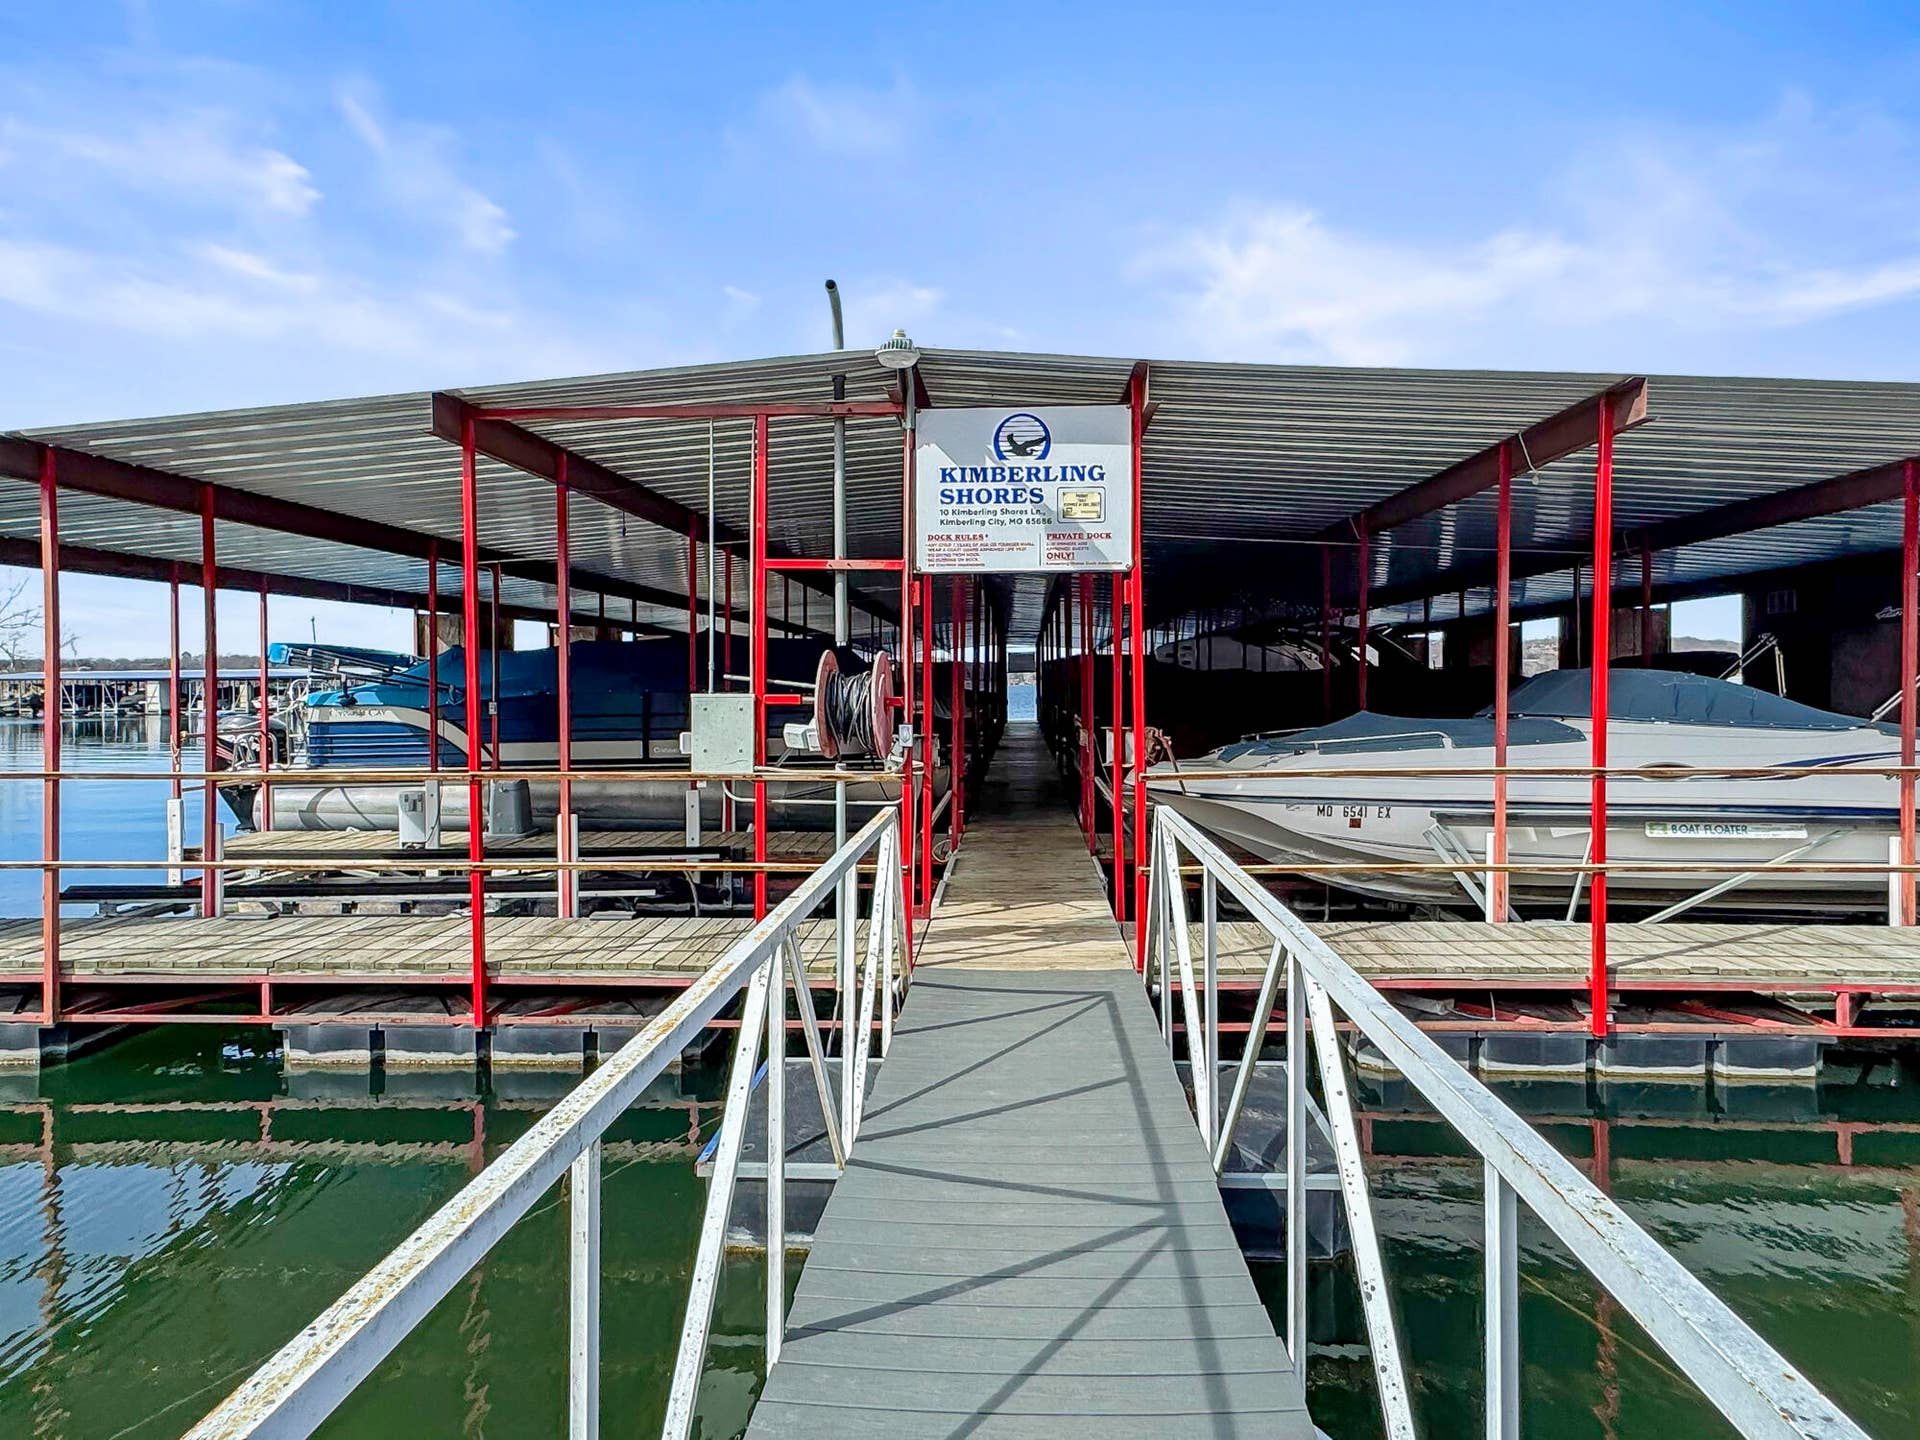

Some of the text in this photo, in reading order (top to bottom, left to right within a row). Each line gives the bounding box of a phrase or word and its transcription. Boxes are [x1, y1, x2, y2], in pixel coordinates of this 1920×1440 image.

[939, 465, 1106, 483] KIMBERLING
[939, 487, 1044, 505] SHORES
[939, 509, 950, 517] 10
[951, 508, 998, 518] Kimberling
[1000, 508, 1029, 516] Shores
[939, 518, 985, 527] Kimberling
[987, 518, 1007, 527] City,
[1046, 552, 1075, 560] ONLY!
[1316, 805, 1392, 818] MO 6541 EX
[1671, 824, 1748, 835] BOAT FLOATER
